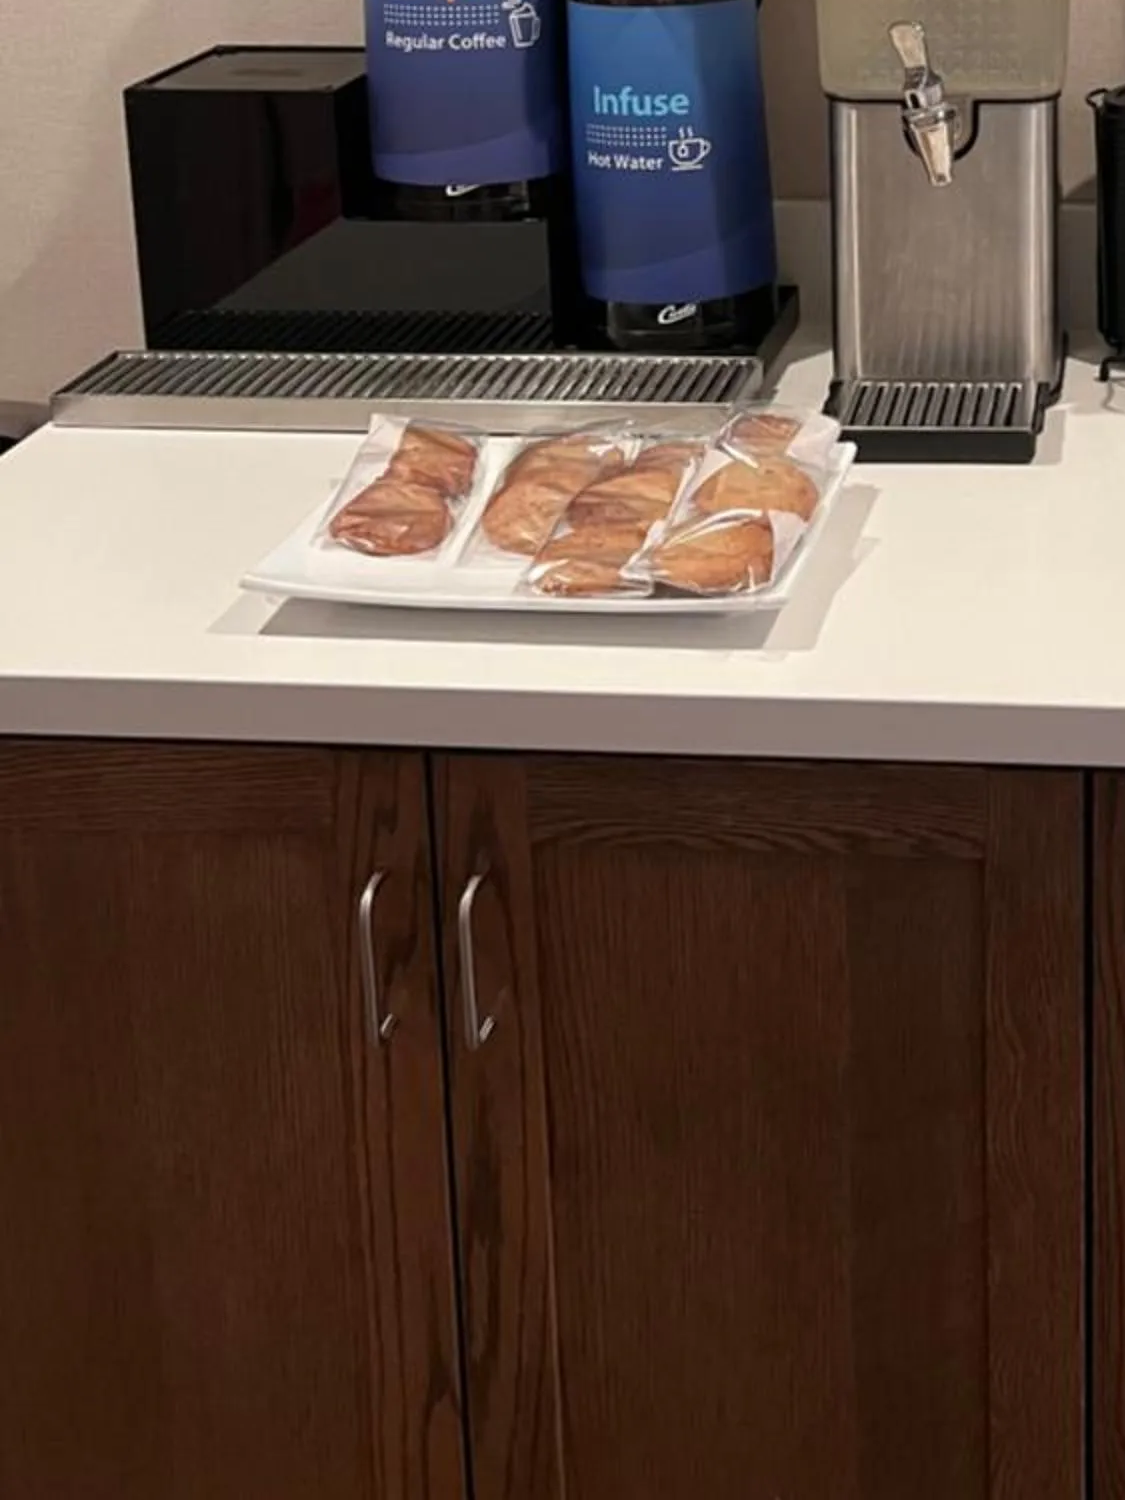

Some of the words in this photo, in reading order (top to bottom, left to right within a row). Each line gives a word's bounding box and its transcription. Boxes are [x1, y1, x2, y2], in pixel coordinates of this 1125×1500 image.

[385, 30, 444, 53] Regular
[448, 31, 507, 51] Coffee
[593, 85, 690, 117] Infuse
[587, 151, 612, 169] Hot
[614, 153, 664, 171] Water
